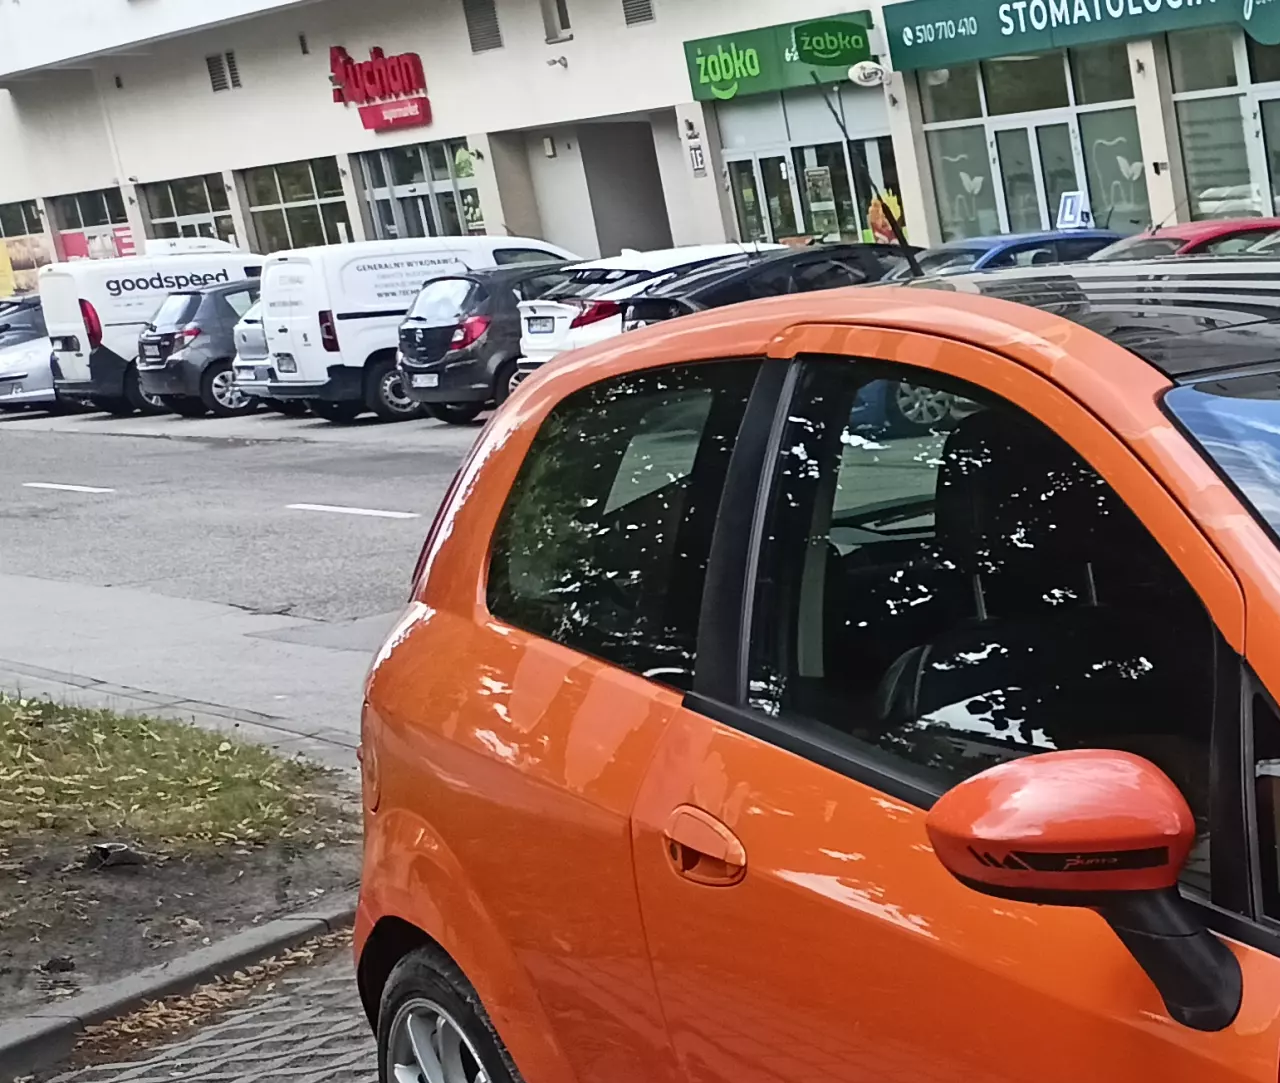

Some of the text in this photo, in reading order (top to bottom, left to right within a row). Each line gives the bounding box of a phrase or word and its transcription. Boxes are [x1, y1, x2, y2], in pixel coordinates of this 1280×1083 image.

[801, 31, 864, 51] żabka
[915, 16, 978, 43] 510 710 410
[328, 45, 428, 106] Auchan
[696, 42, 761, 84] żabka
[105, 268, 230, 297] goodspeed
